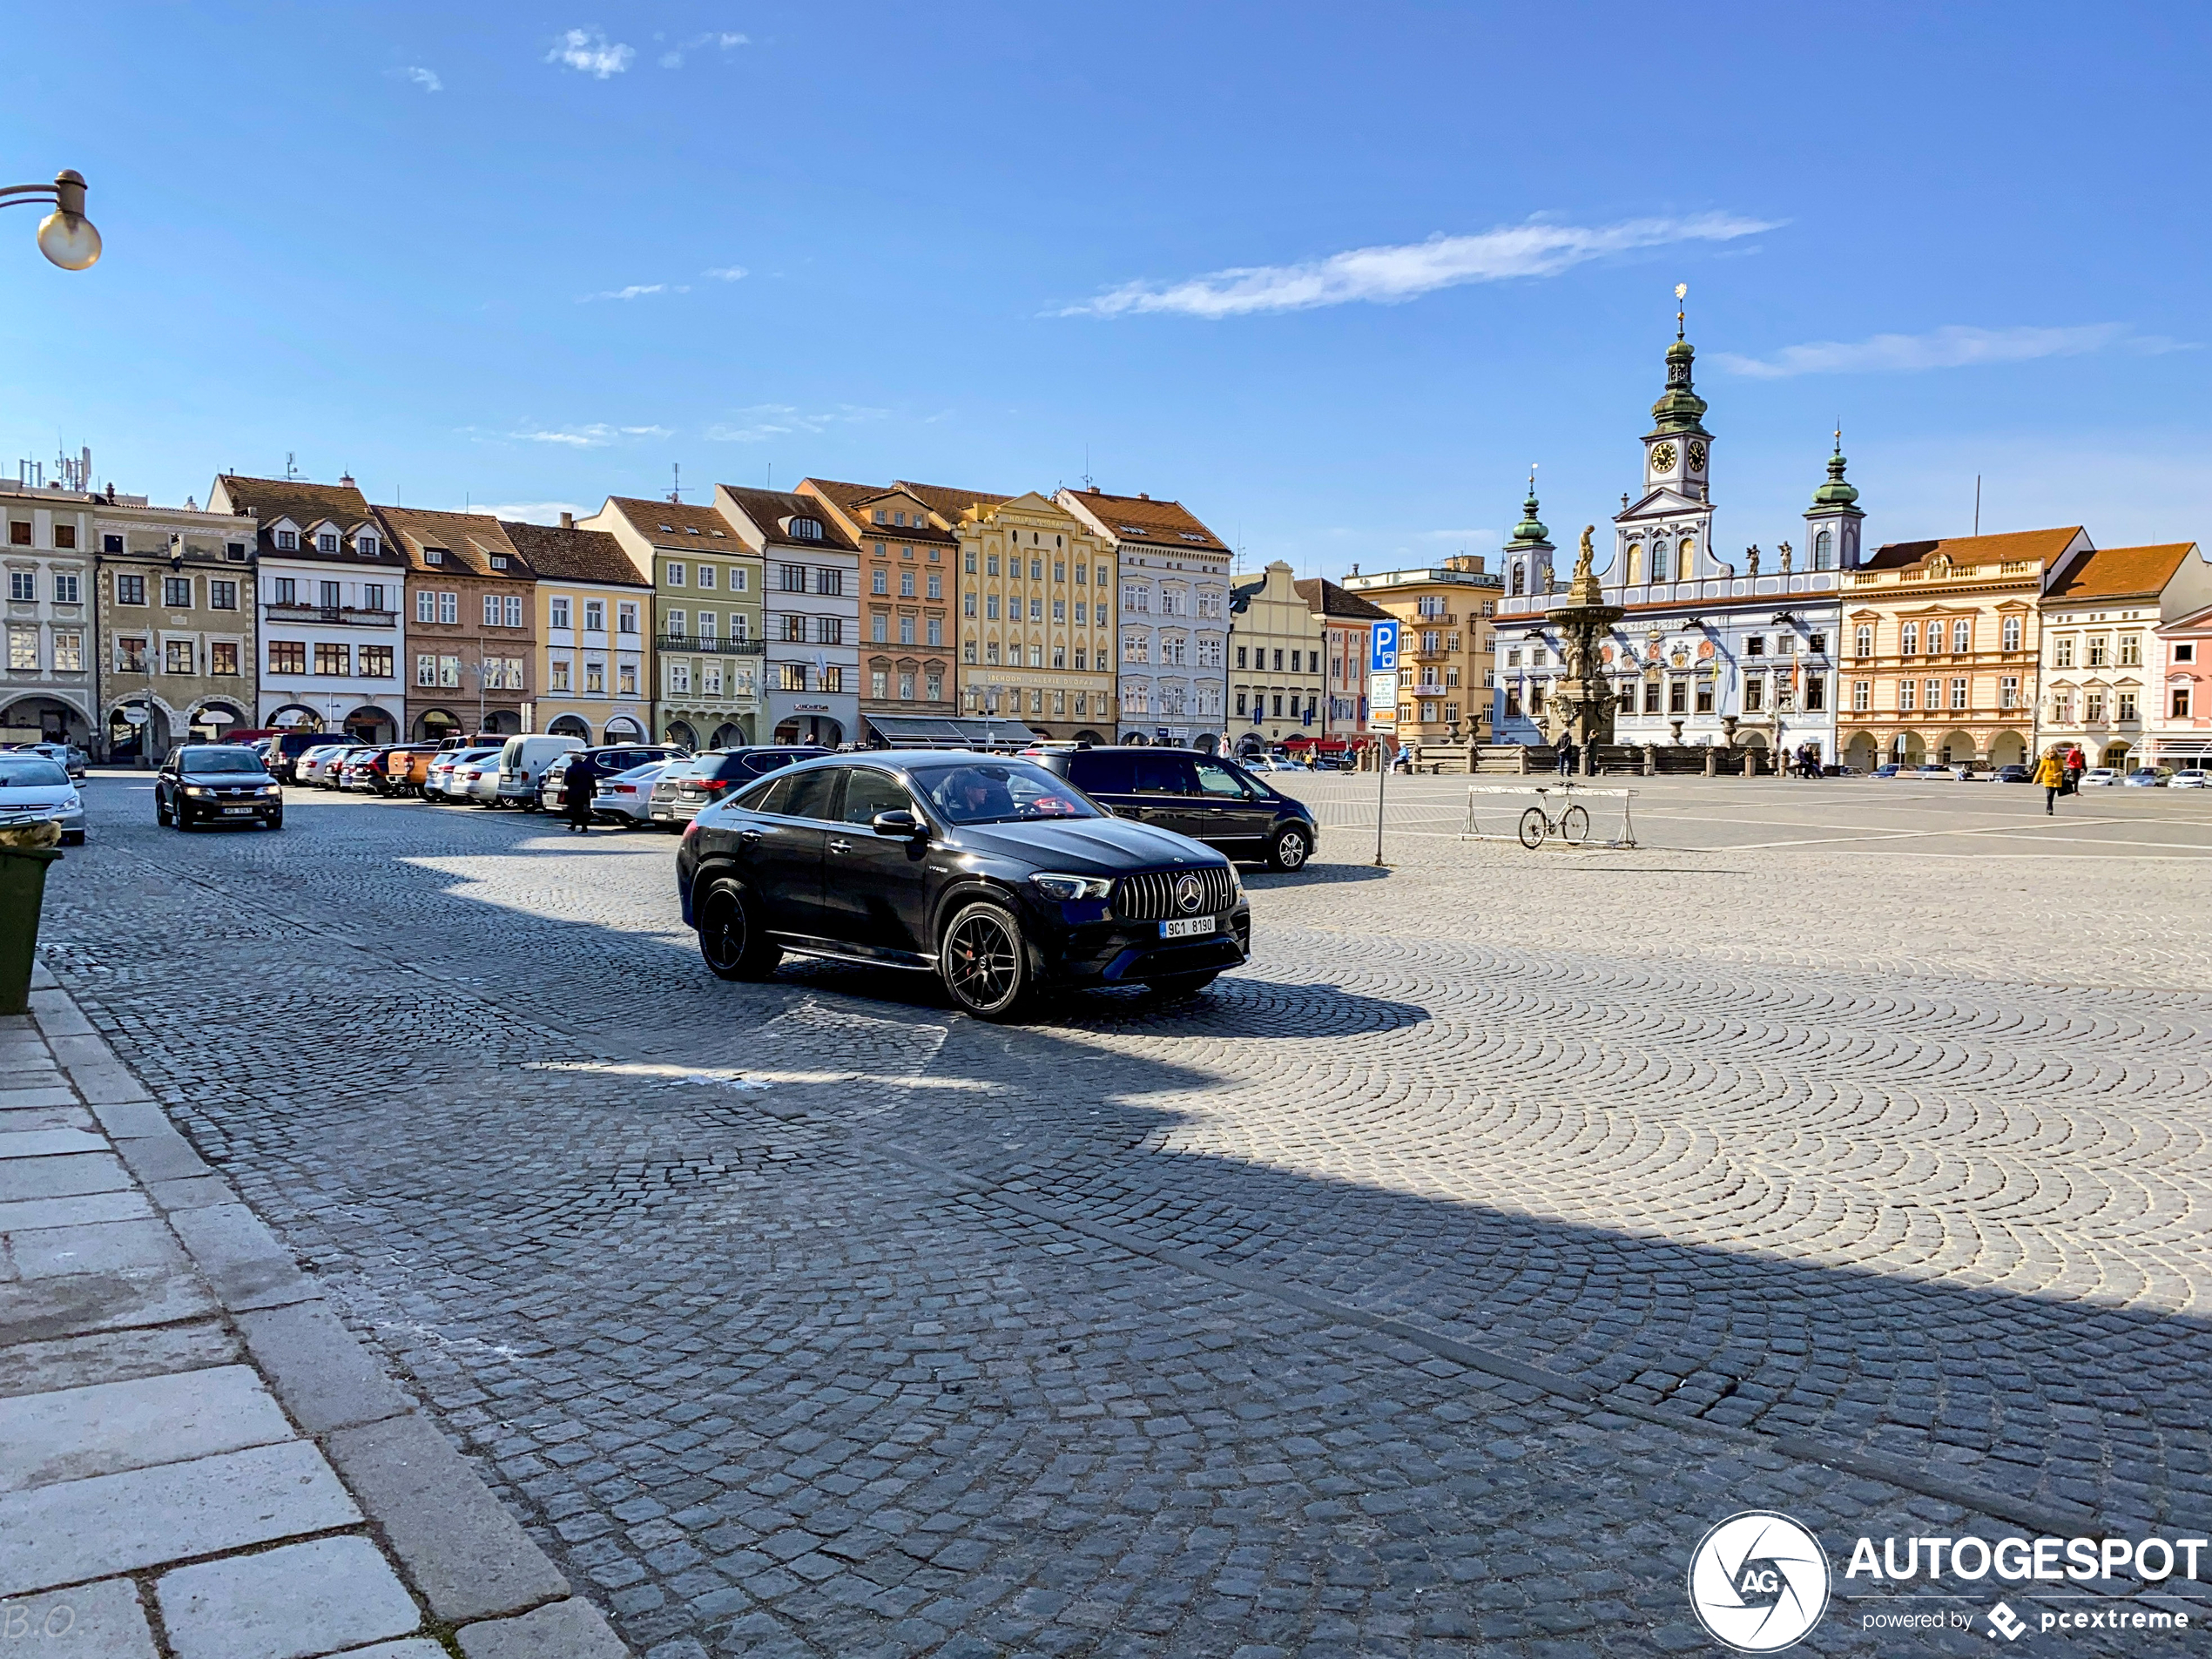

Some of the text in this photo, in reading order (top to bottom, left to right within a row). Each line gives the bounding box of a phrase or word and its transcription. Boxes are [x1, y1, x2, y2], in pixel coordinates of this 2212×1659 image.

[1376, 627, 1393, 656] P
[1028, 676, 1060, 685] GALERIE
[1168, 919, 1212, 935] 9C1 8190
